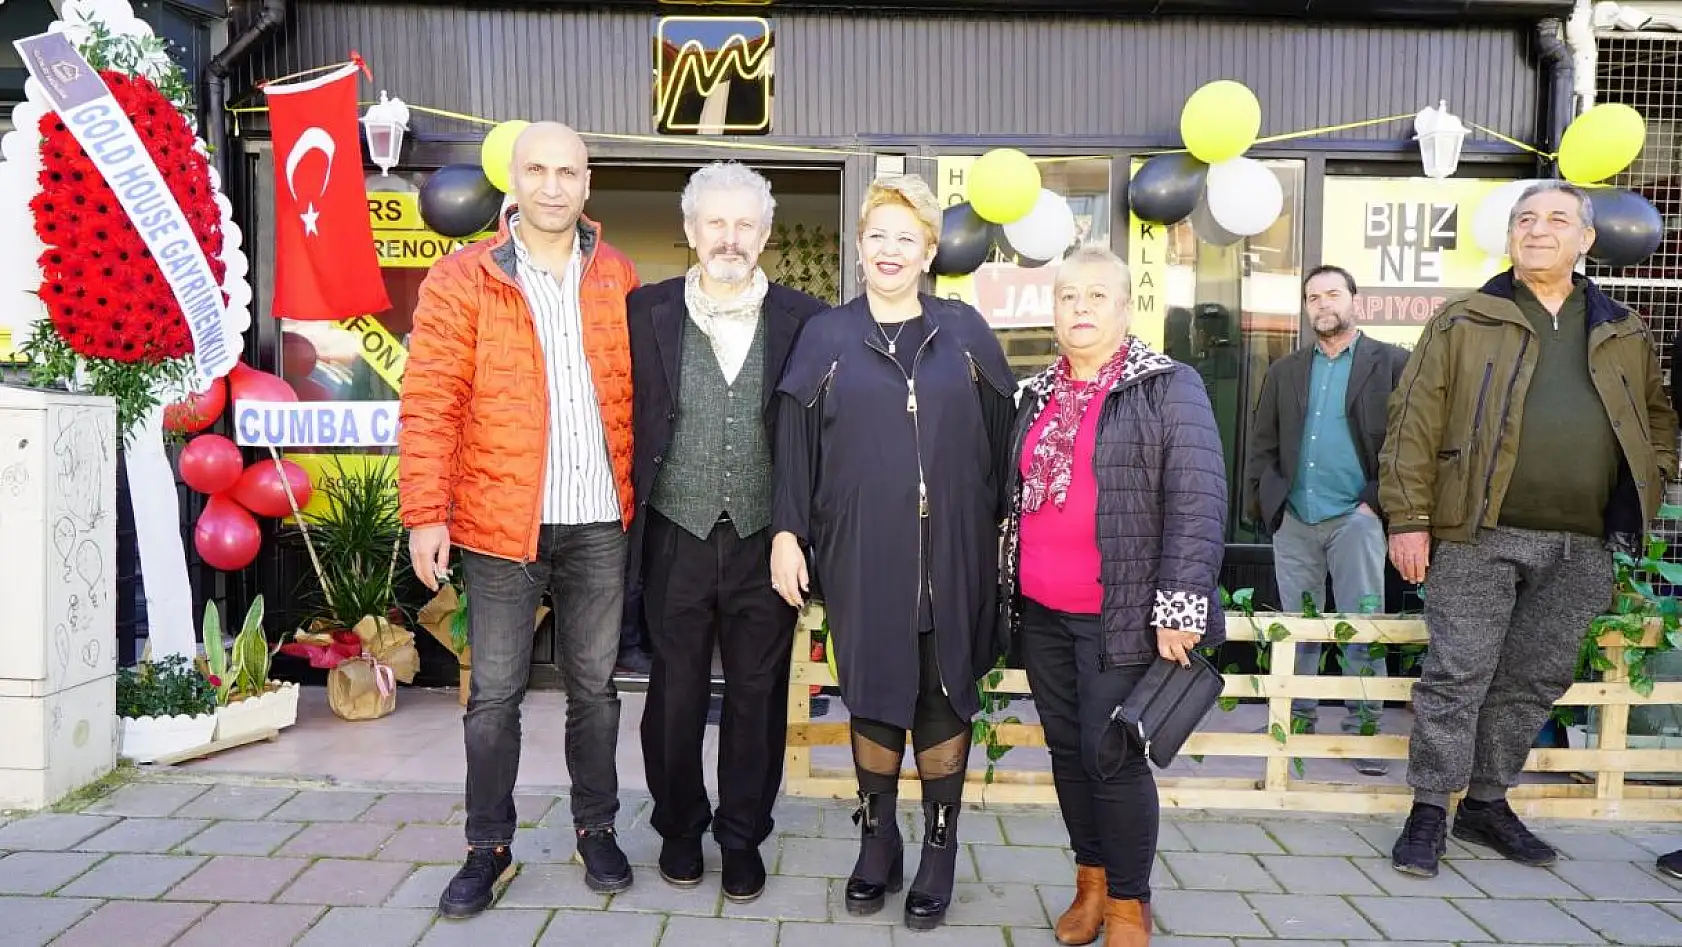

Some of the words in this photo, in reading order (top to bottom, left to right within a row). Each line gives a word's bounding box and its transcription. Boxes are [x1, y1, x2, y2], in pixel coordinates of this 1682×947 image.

[367, 199, 402, 222] RS
[71, 104, 136, 166] GOLD
[113, 162, 180, 242] HOUSE
[159, 239, 230, 378] GAYRİMENKUL
[373, 239, 476, 258] RENOV
[1137, 222, 1155, 313] KLAM
[1378, 246, 1441, 283] NE
[1353, 296, 1446, 321] APIYO
[341, 315, 402, 372] FON
[239, 408, 361, 444] CUMBA
